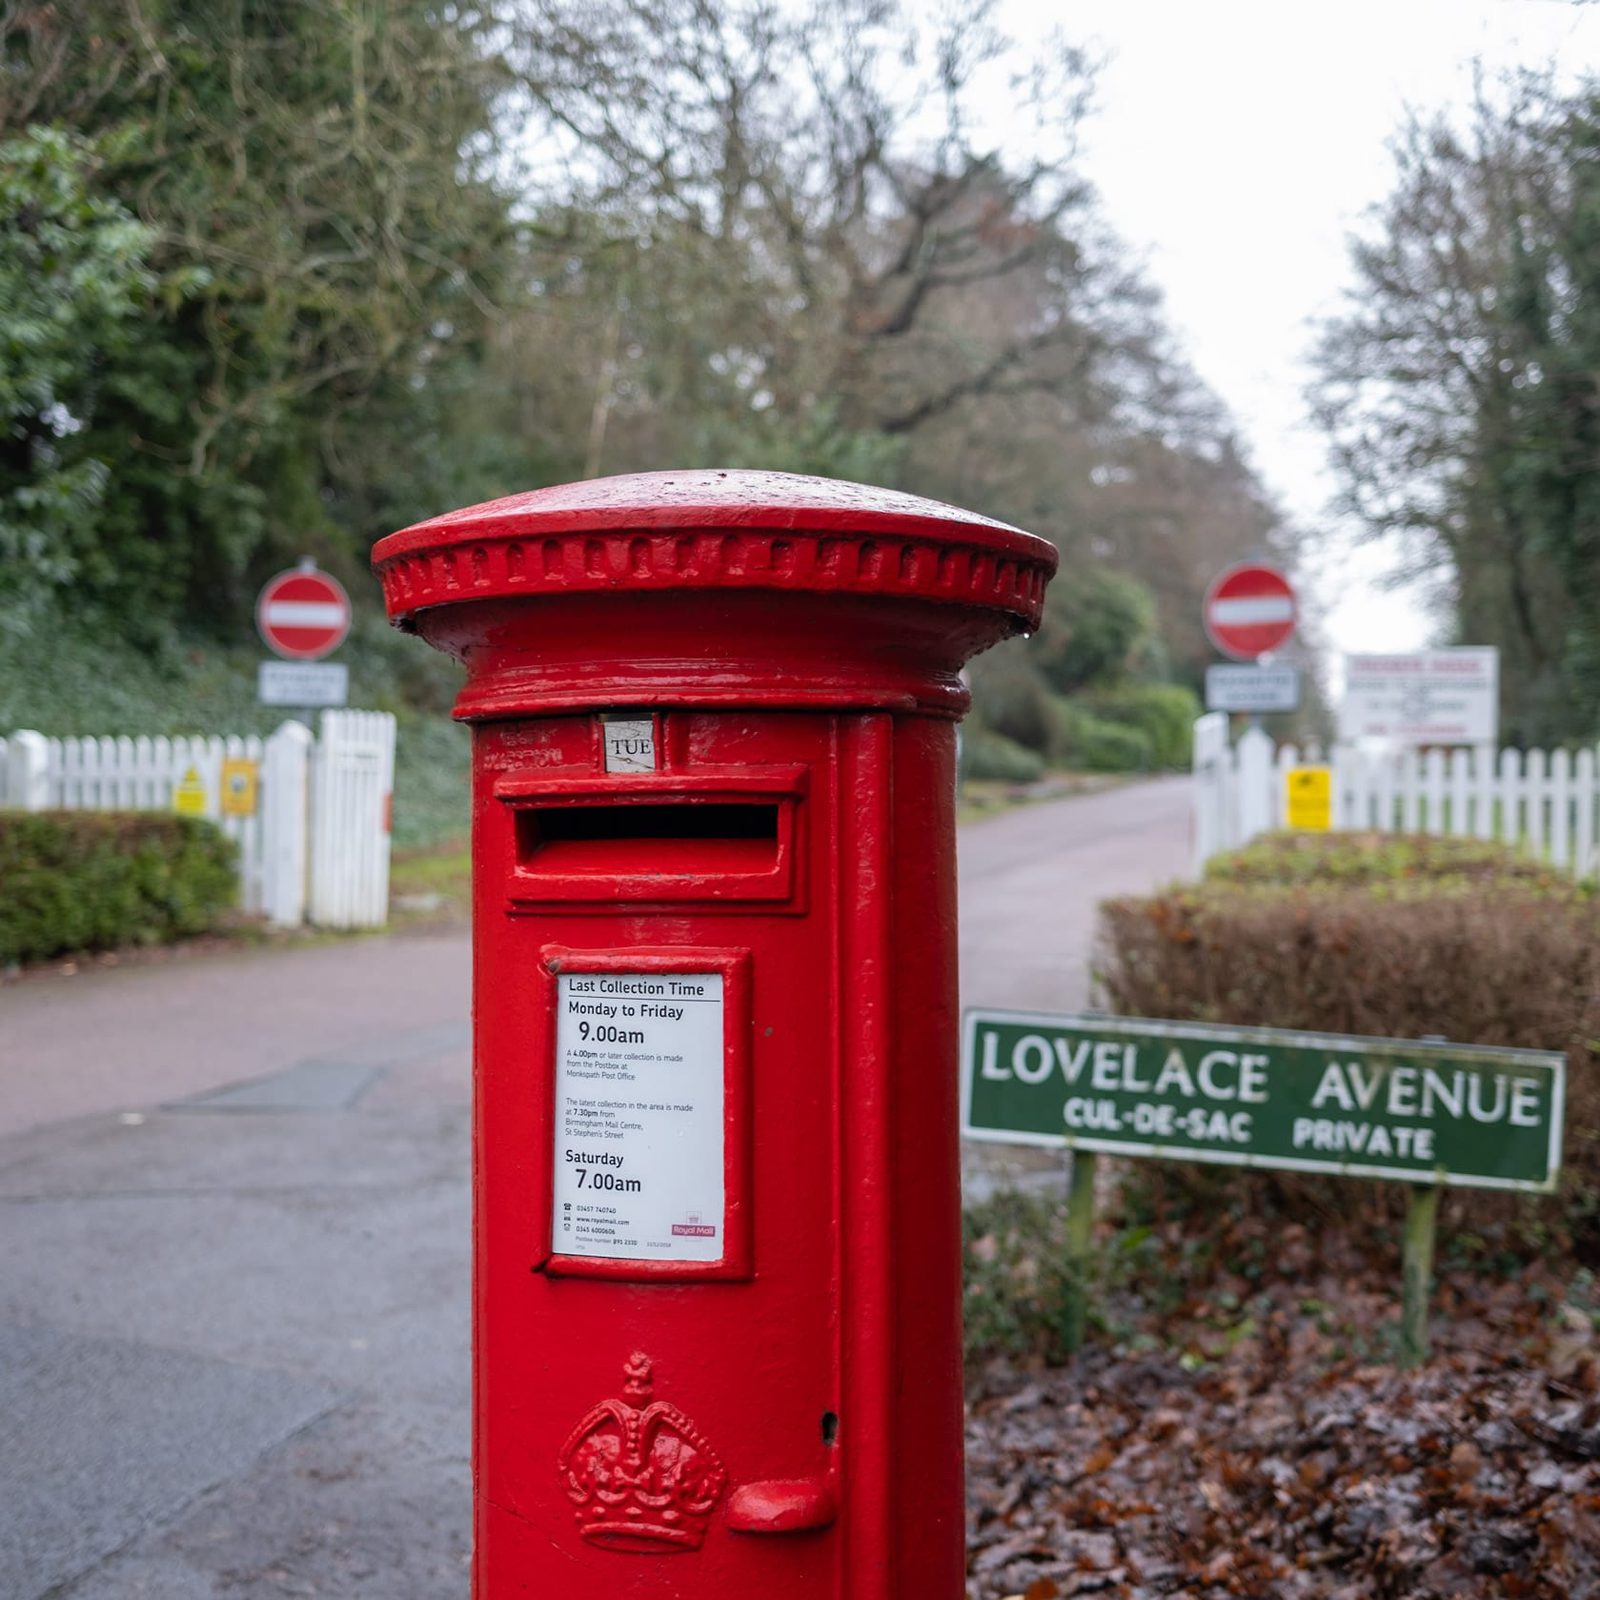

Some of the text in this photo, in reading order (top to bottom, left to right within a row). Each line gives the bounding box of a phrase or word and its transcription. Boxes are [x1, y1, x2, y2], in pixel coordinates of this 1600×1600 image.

[611, 739, 650, 754] TUE
[569, 979, 704, 995] Last Collection Time
[569, 1001, 683, 1020] Monday to Friday
[579, 1022, 644, 1043] 9.00am
[573, 1050, 597, 1059] 4.00pm
[595, 1061, 619, 1069] Postbox
[981, 1030, 1542, 1126] LOVELACE AVENUE
[597, 1100, 627, 1109] collection
[573, 1109, 598, 1118] 7.30pm
[565, 1118, 603, 1128] Birmingham
[1064, 1098, 1435, 1159] CUL-DE-SAC PRIVATE
[604, 1130, 624, 1139] Street
[565, 1150, 624, 1167] Saturday
[575, 1169, 641, 1192] 7.00am
[673, 1225, 714, 1234] Royal Mail
